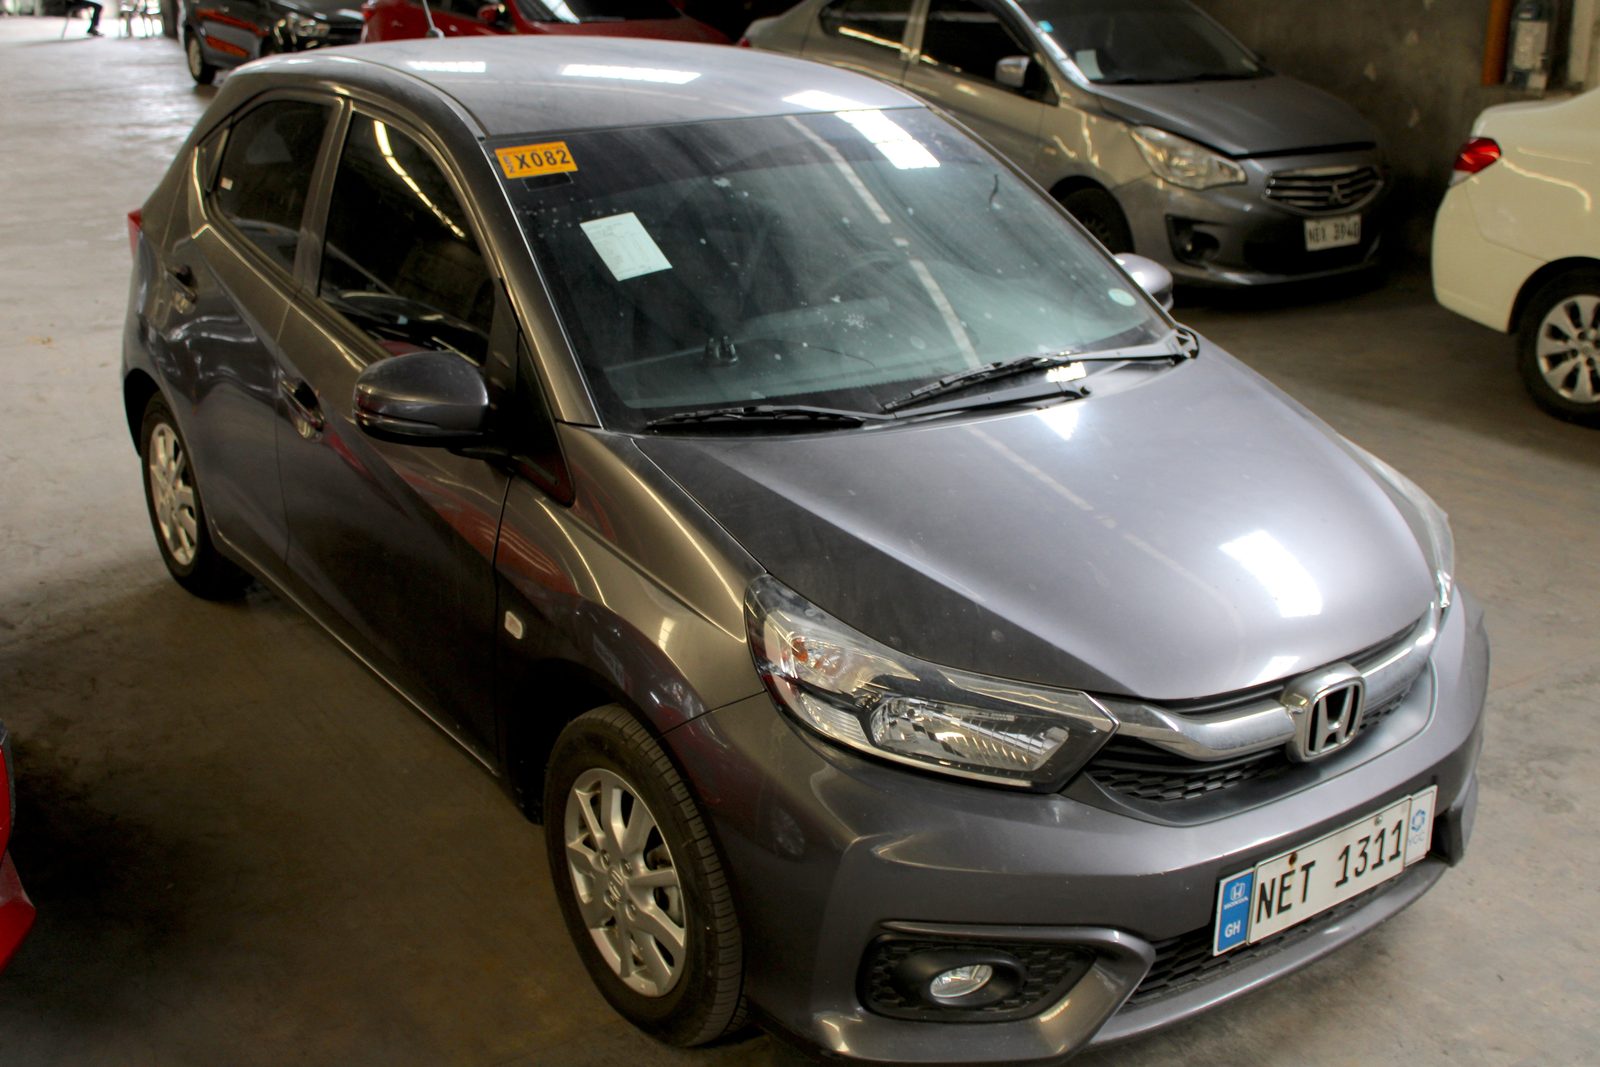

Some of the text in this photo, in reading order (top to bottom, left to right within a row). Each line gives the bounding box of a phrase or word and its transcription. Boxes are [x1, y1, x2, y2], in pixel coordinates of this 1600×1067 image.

[514, 149, 571, 170] X082
[1256, 819, 1403, 924] NET 1311
[1223, 895, 1249, 911] HONDA
[1225, 919, 1241, 939] GH
